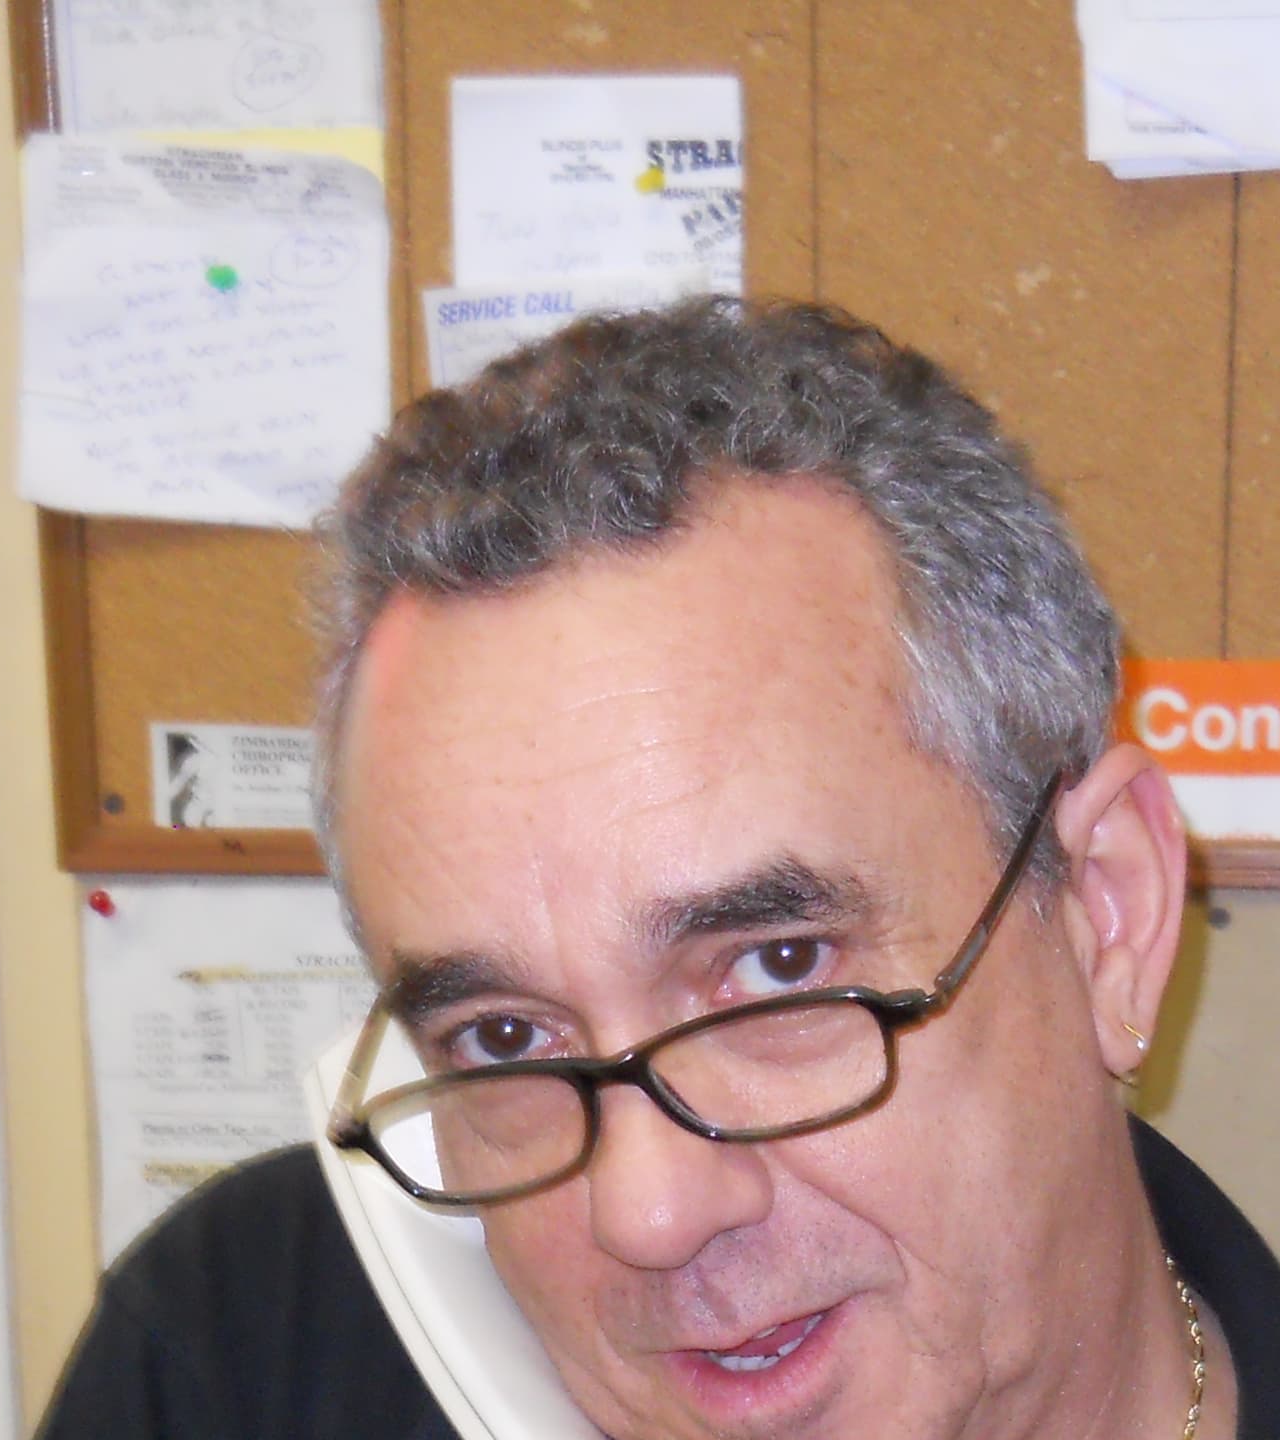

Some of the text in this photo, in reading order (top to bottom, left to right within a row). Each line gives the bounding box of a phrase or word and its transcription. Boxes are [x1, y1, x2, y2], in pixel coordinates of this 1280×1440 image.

[646, 138, 743, 174] STRA
[437, 290, 575, 327] SERVICE CALL
